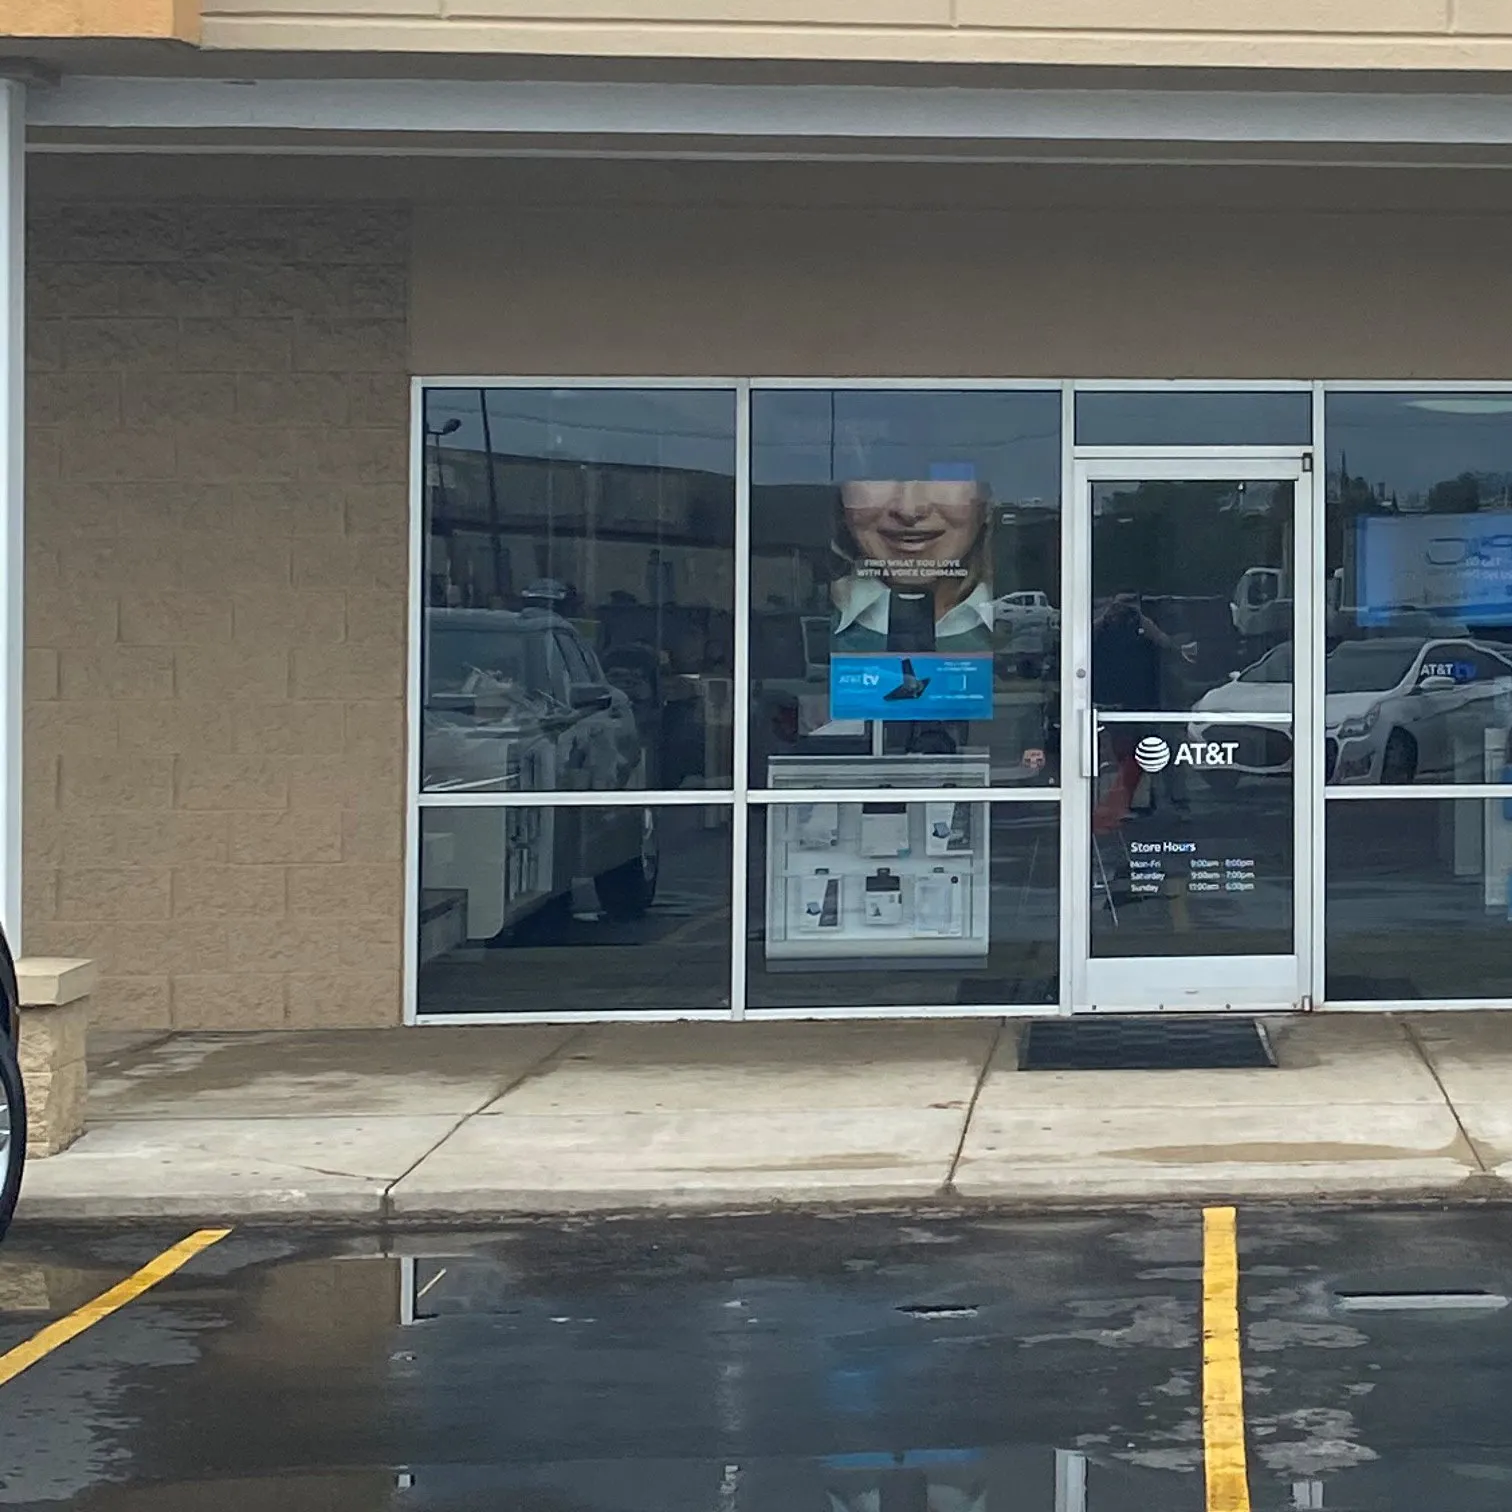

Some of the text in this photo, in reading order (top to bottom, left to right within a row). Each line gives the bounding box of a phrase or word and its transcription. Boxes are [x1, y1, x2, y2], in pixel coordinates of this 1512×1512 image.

[887, 559, 913, 568] WHAT
[937, 559, 960, 568] LOVE
[856, 569, 880, 577] WITH
[882, 568, 890, 577] A
[920, 569, 968, 577] COMMAND
[1420, 663, 1454, 676] AT&T
[862, 672, 880, 686] tv
[1174, 742, 1240, 765] AT&T
[1130, 841, 1197, 853] Store Hours
[1129, 859, 1162, 869] Mon-Fri
[1130, 872, 1166, 882] Saturday
[1130, 884, 1159, 894] Sunday
